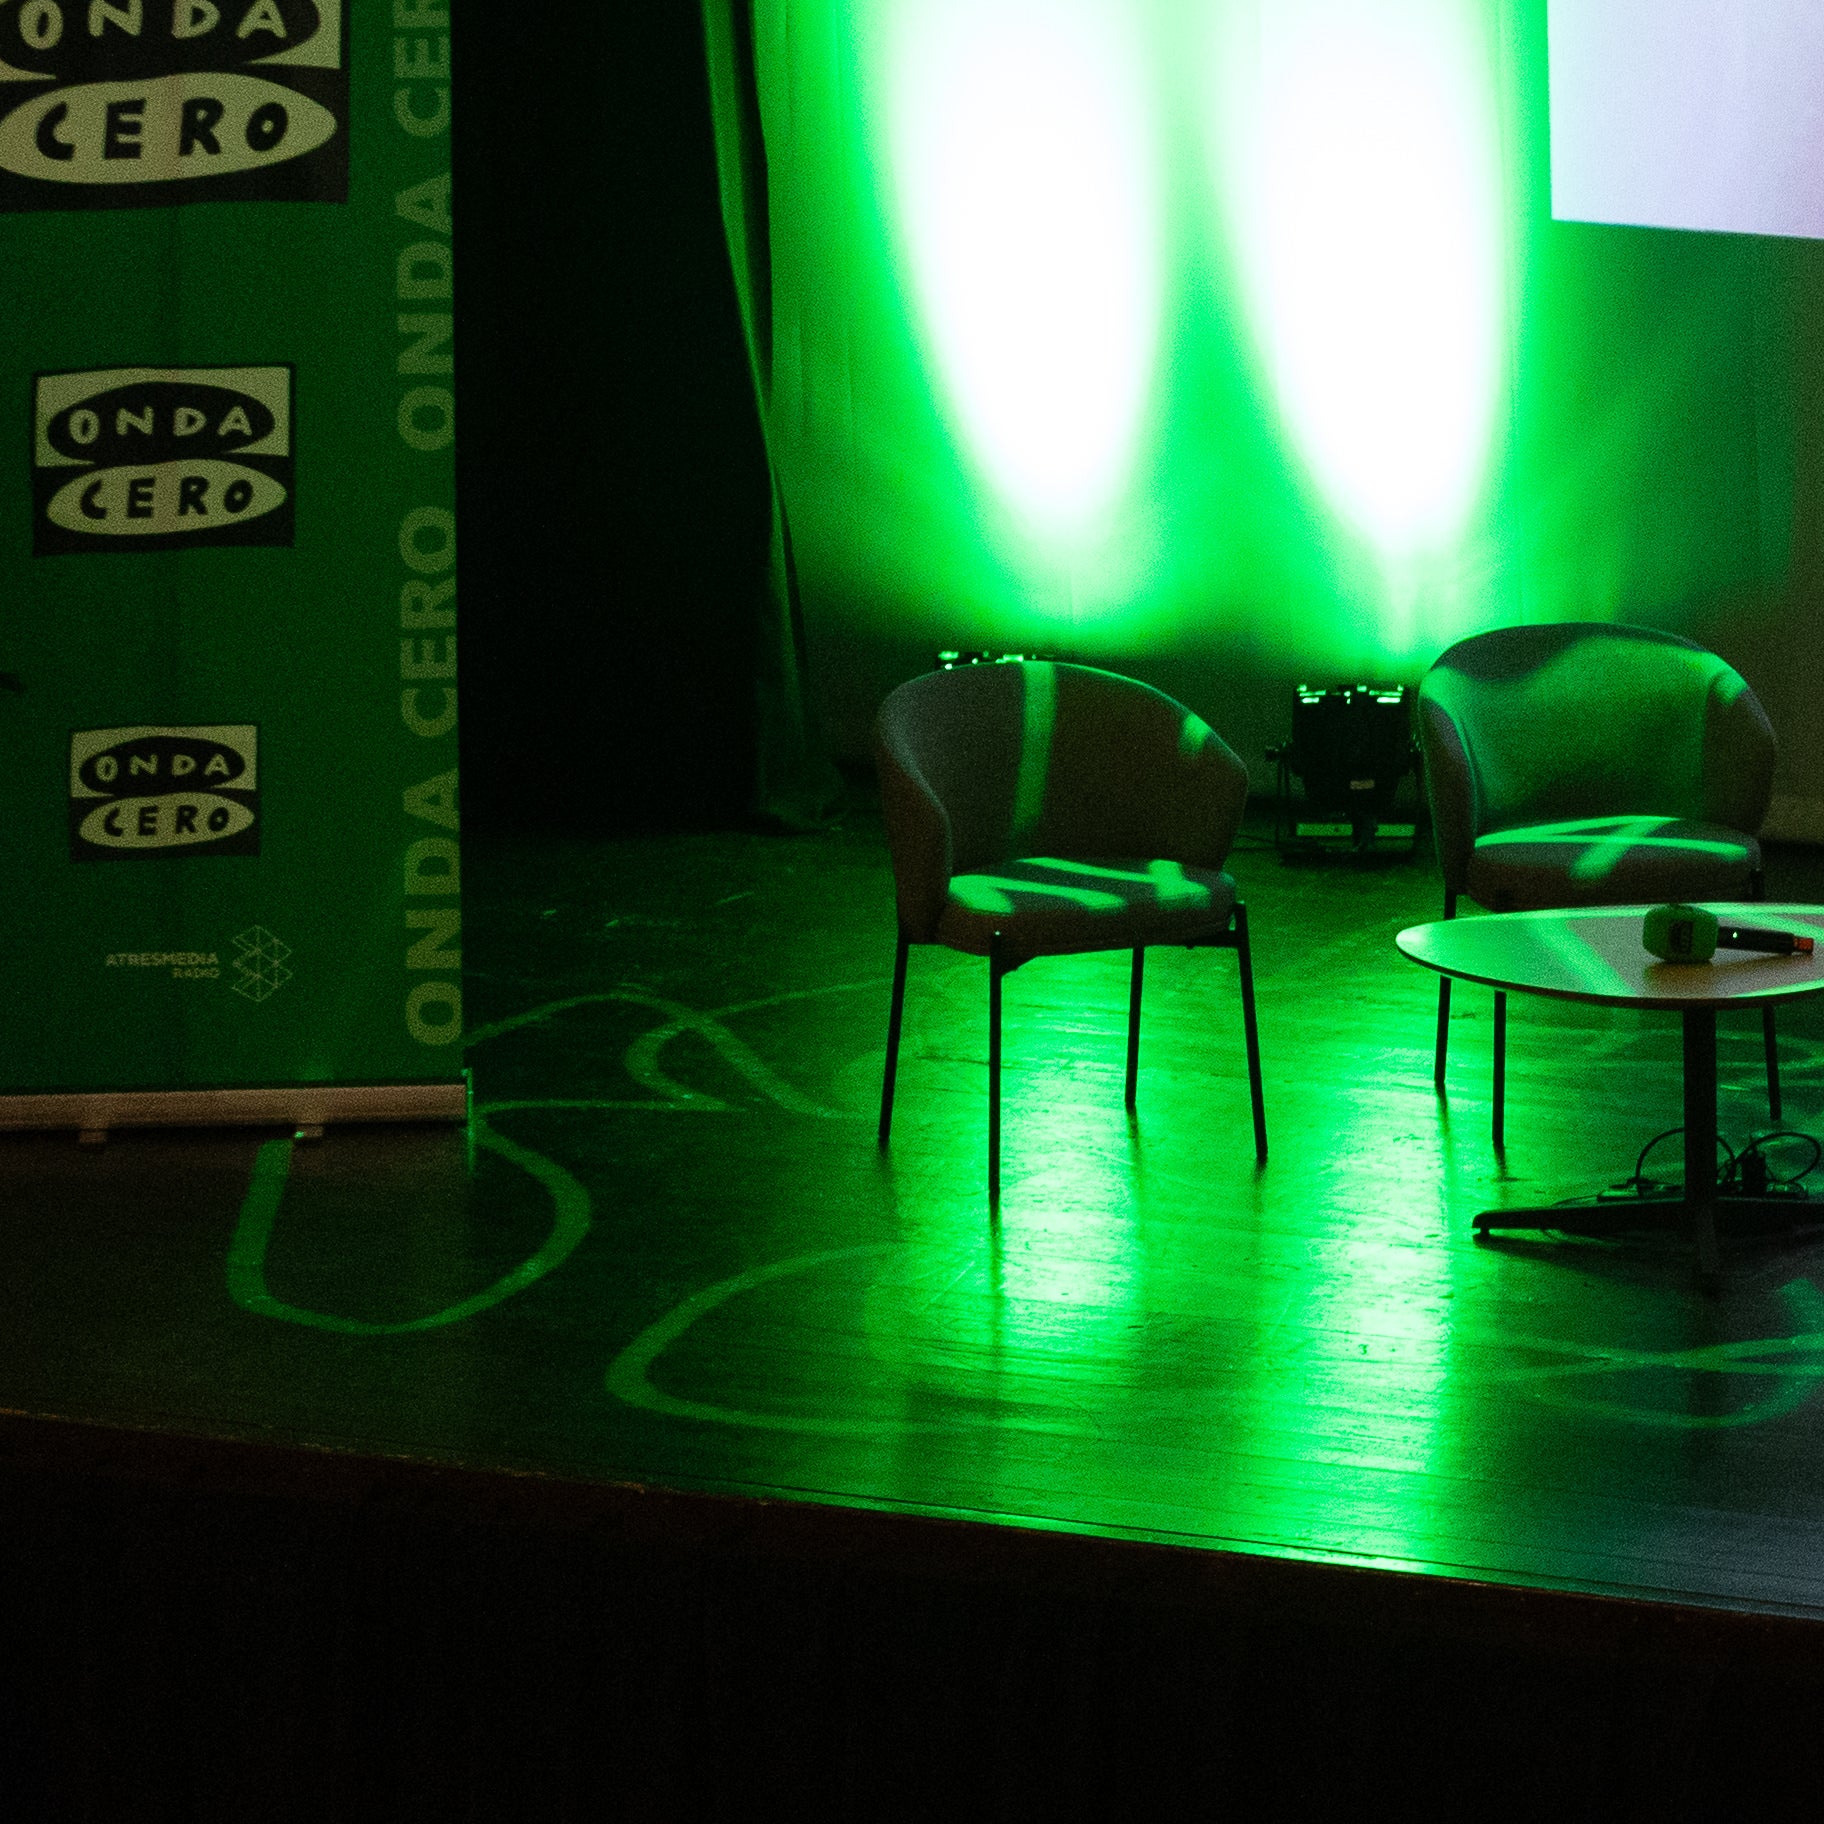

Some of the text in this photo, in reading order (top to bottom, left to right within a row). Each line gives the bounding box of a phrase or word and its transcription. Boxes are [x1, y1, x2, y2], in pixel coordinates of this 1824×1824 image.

[35, 97, 288, 161] CERO
[394, 175, 455, 452] ONDA
[67, 404, 253, 445] ONDA
[80, 476, 254, 520] CERO
[399, 506, 458, 738] CERO
[94, 752, 230, 783] ONDA
[103, 804, 230, 837] CERO
[401, 768, 463, 1046] ONDA
[104, 951, 220, 968] ATRESMEDIA
